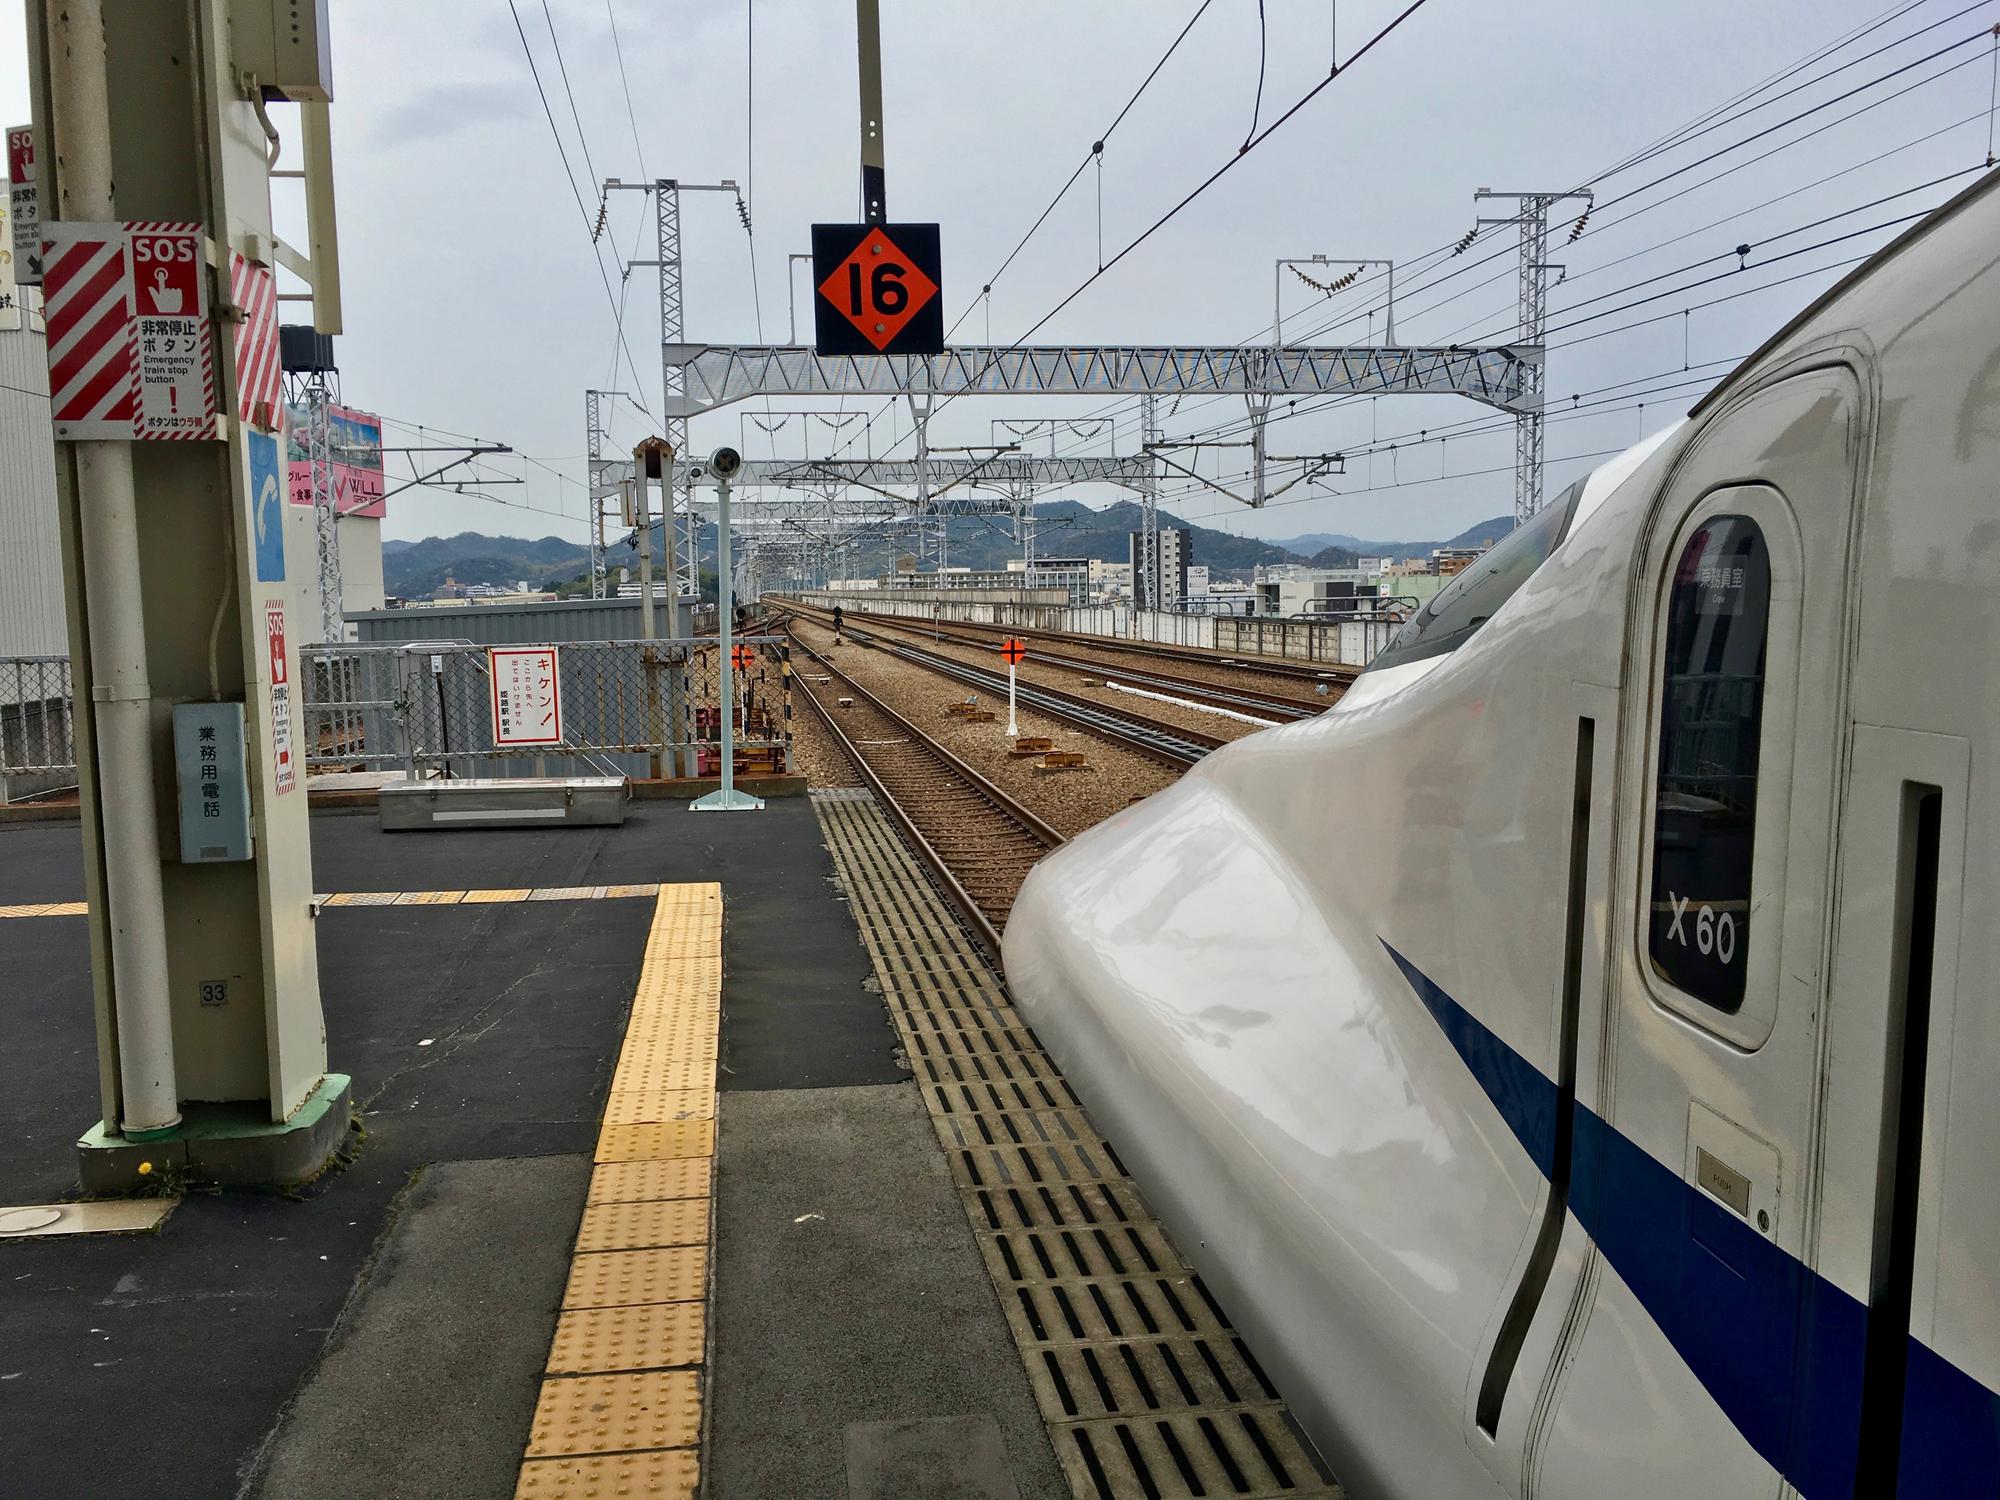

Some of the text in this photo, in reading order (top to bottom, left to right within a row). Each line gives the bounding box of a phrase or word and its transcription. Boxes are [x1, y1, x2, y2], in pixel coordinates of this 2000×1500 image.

[12, 133, 33, 150] SO
[13, 188, 36, 203] 非常
[14, 206, 36, 220] ボタ
[14, 222, 39, 231] Emerge
[135, 238, 193, 262] SOS
[849, 262, 909, 316] 16
[142, 320, 196, 336] 非常停止
[143, 338, 196, 353] ボタン
[144, 355, 195, 366] Emergency
[144, 365, 188, 376] train stop
[145, 375, 175, 384] button
[288, 471, 312, 482] グルー
[268, 612, 284, 637] SOS
[523, 659, 533, 709] ここから先へ
[511, 660, 522, 726] 出てはいけません
[198, 726, 220, 818] 業務用電話
[202, 984, 226, 1001] 33
